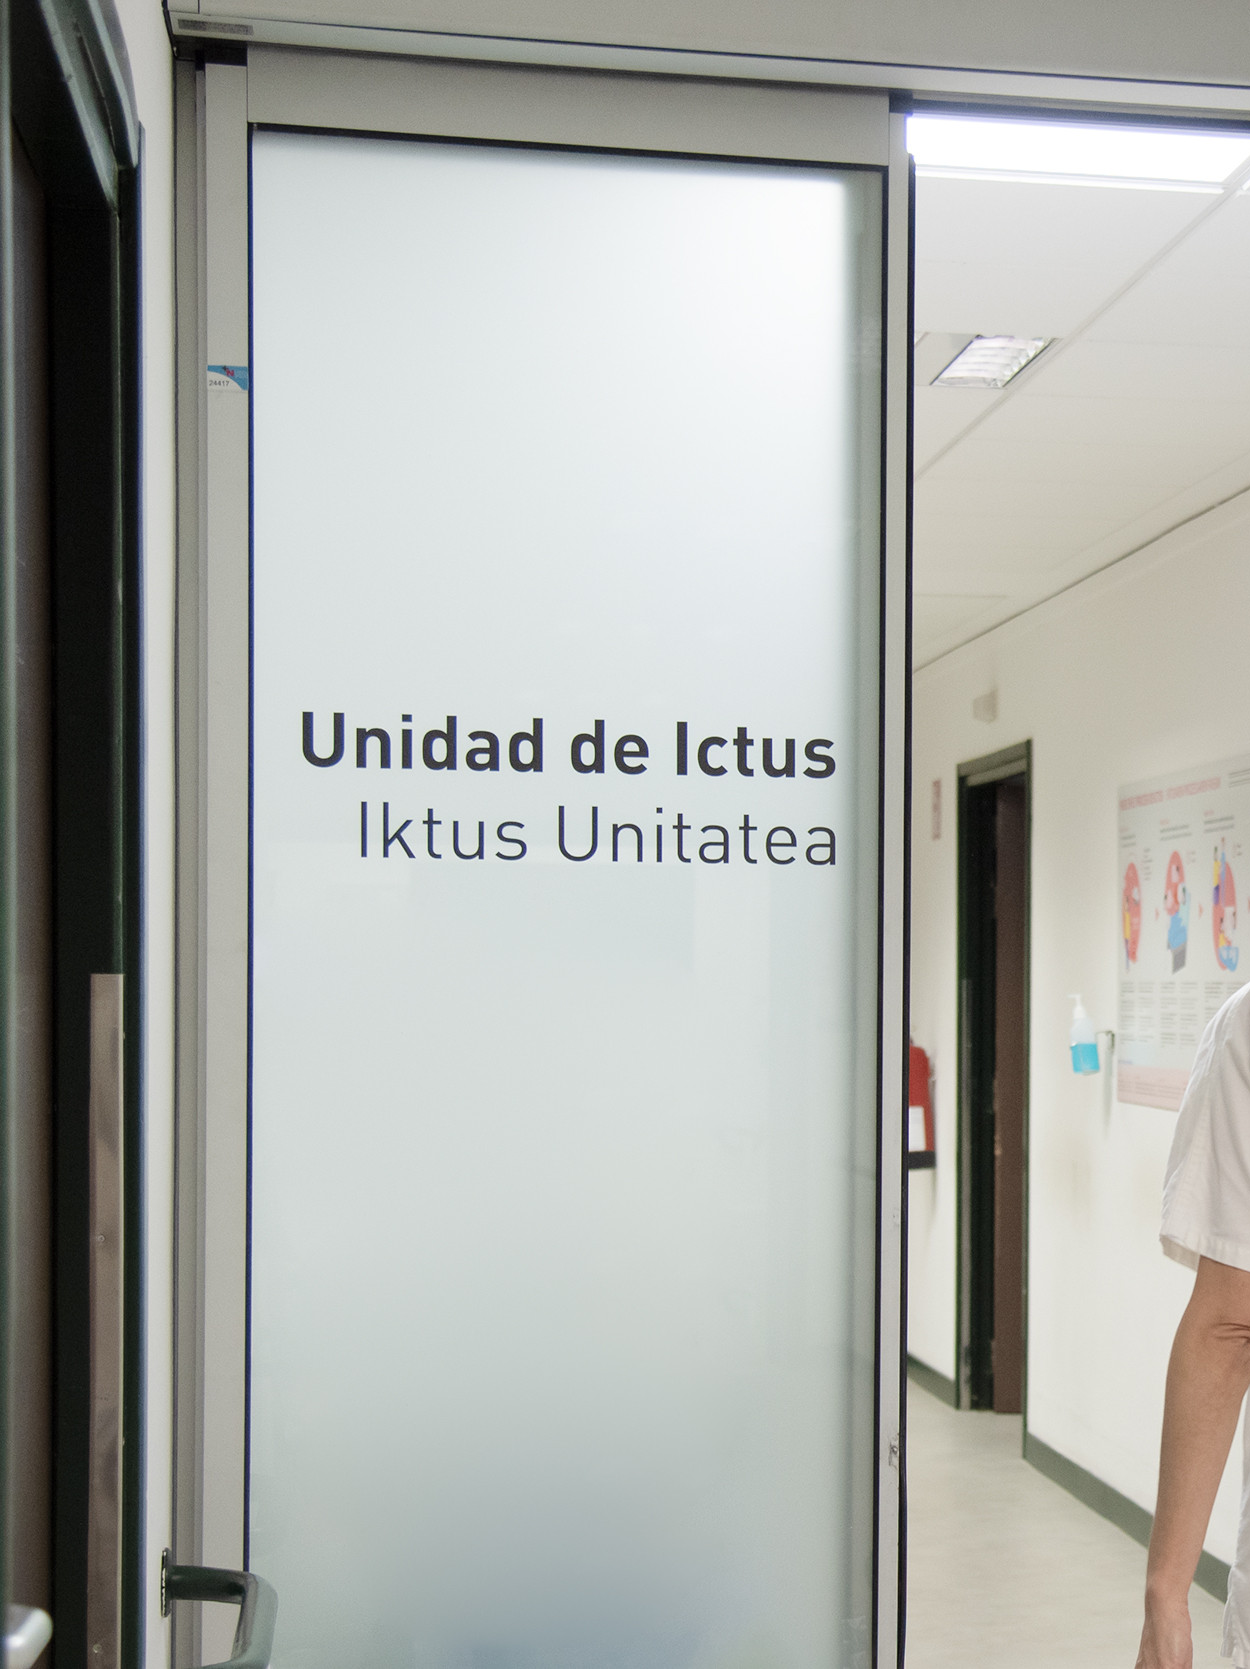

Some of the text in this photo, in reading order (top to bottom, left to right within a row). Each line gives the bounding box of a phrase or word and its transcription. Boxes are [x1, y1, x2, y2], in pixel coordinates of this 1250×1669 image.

[302, 711, 836, 779] Unidad de Ictus
[360, 801, 836, 866] Iktus Unitatea
